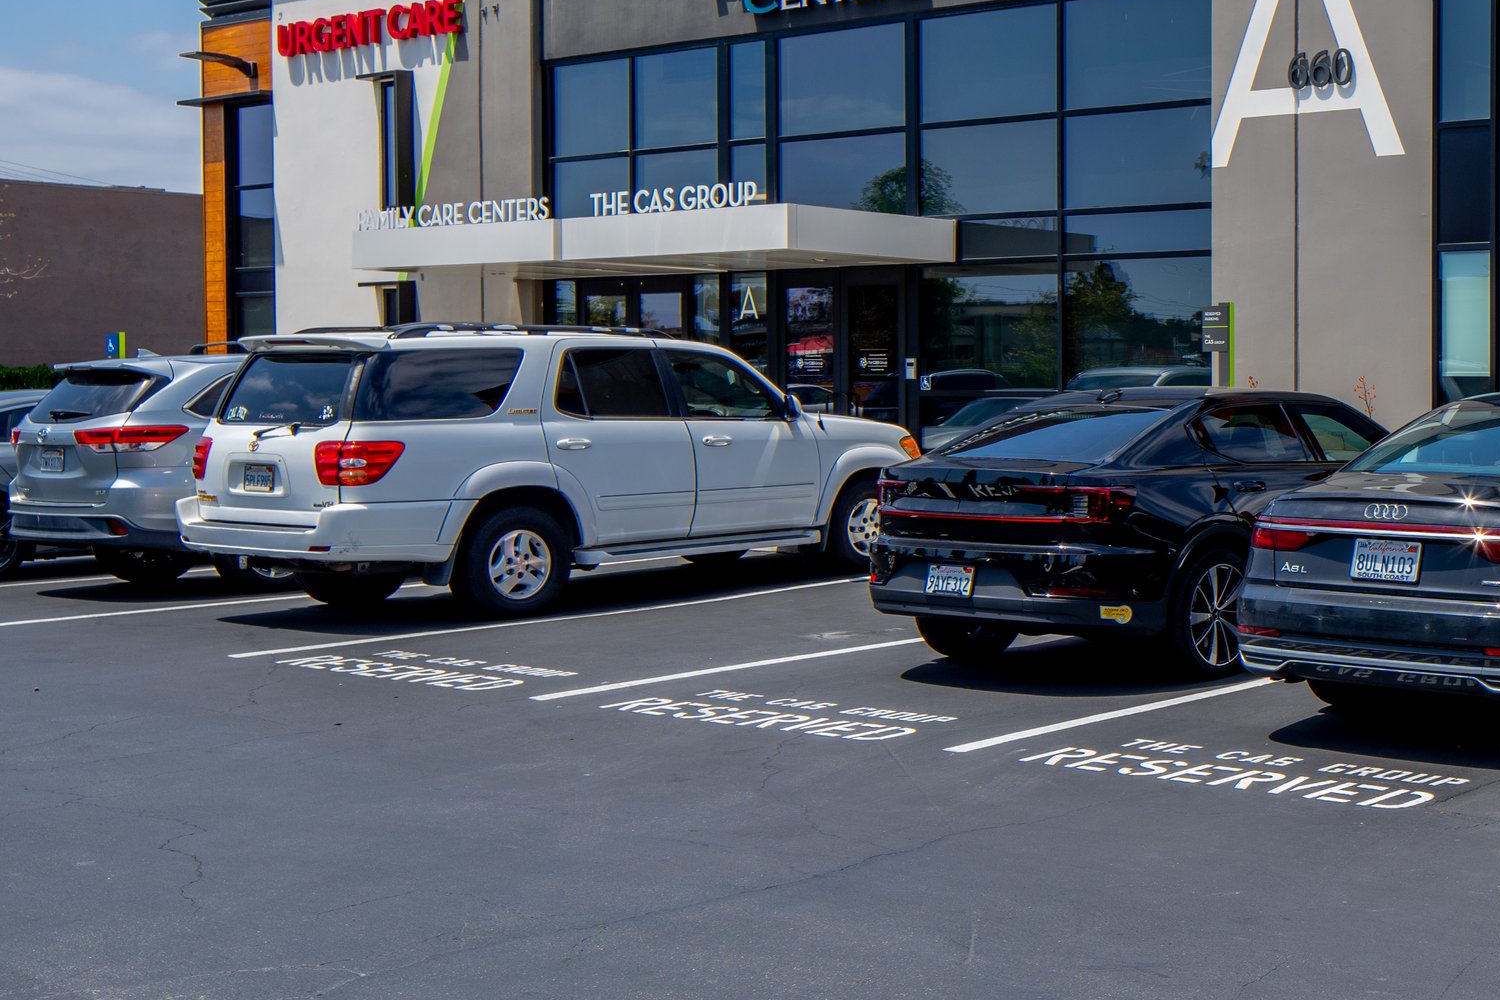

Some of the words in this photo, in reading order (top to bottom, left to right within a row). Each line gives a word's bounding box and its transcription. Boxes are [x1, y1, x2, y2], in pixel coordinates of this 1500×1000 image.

[277, 8, 387, 57] URGENT
[1288, 48, 1353, 89] 660
[356, 206, 415, 231] FAMILY
[417, 202, 464, 227] CARE
[468, 197, 549, 223] CENTERS
[590, 191, 630, 216] THE
[634, 187, 675, 214] CAS
[679, 181, 757, 210] GROUP
[739, 286, 759, 319] A
[1357, 554, 1414, 574] 8ULN103
[1368, 543, 1406, 554] California
[927, 575, 971, 592] 9AYF312
[275, 655, 524, 690] RESERVED
[372, 650, 430, 659] THE
[426, 658, 487, 666] CAS
[482, 664, 578, 677] GROUP
[600, 697, 916, 740] RESERVED
[696, 690, 764, 701] THE
[766, 698, 837, 709] CAS
[840, 706, 958, 723] GROUP
[1018, 747, 1435, 809] RESERVED
[1120, 738, 1203, 754] THE
[1215, 751, 1304, 766] CAS
[1318, 763, 1470, 786] GROUP
